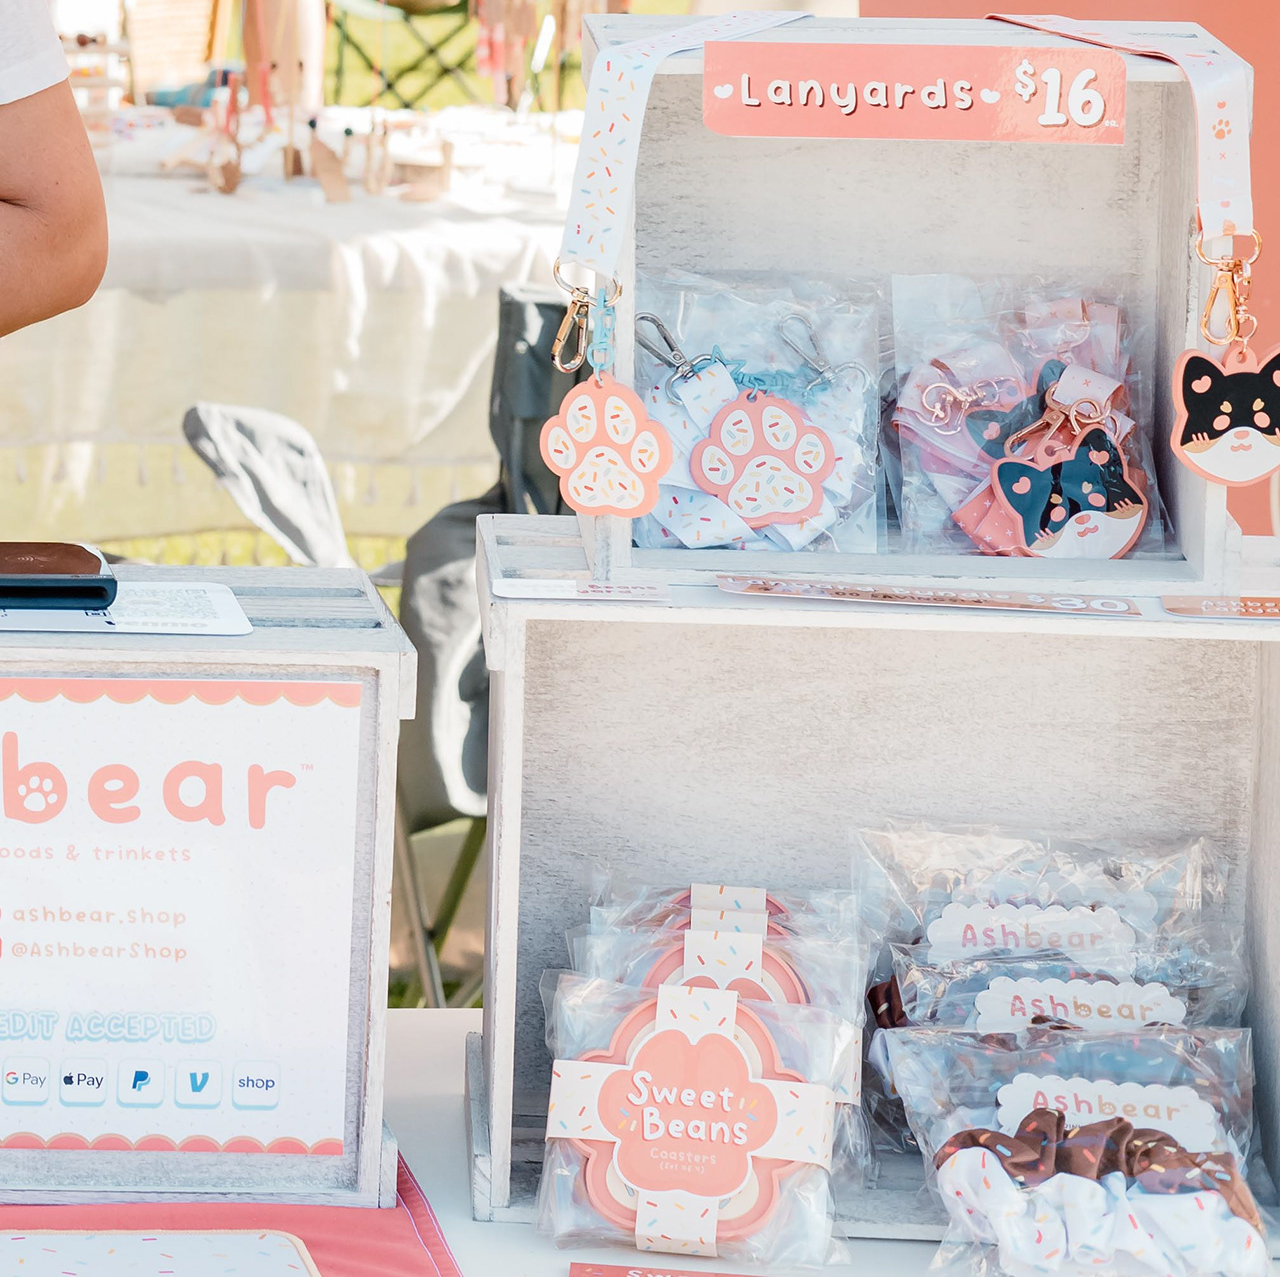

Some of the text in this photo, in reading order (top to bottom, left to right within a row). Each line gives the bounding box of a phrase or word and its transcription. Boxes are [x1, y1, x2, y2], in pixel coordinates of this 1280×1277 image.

[740, 73, 974, 116] Lanyards
[1014, 59, 1107, 128] $16
[1027, 594, 1129, 612] $30
[66, 843, 80, 861] &
[92, 844, 192, 862] trinkets
[12, 906, 187, 927] ashbear.shop
[961, 923, 1104, 948] Ashbear
[11, 941, 188, 963] @AshbearShop
[1010, 994, 1154, 1021] Ashbear
[65, 1010, 217, 1044] ACCEPTED
[22, 1072, 46, 1089] Pay
[77, 1073, 104, 1089] Pay
[238, 1076, 275, 1090] shop
[627, 1071, 734, 1112] Sweet
[1032, 1090, 1180, 1121] Ashbear
[642, 1106, 748, 1146] Beans
[650, 1147, 717, 1165] Coasters
